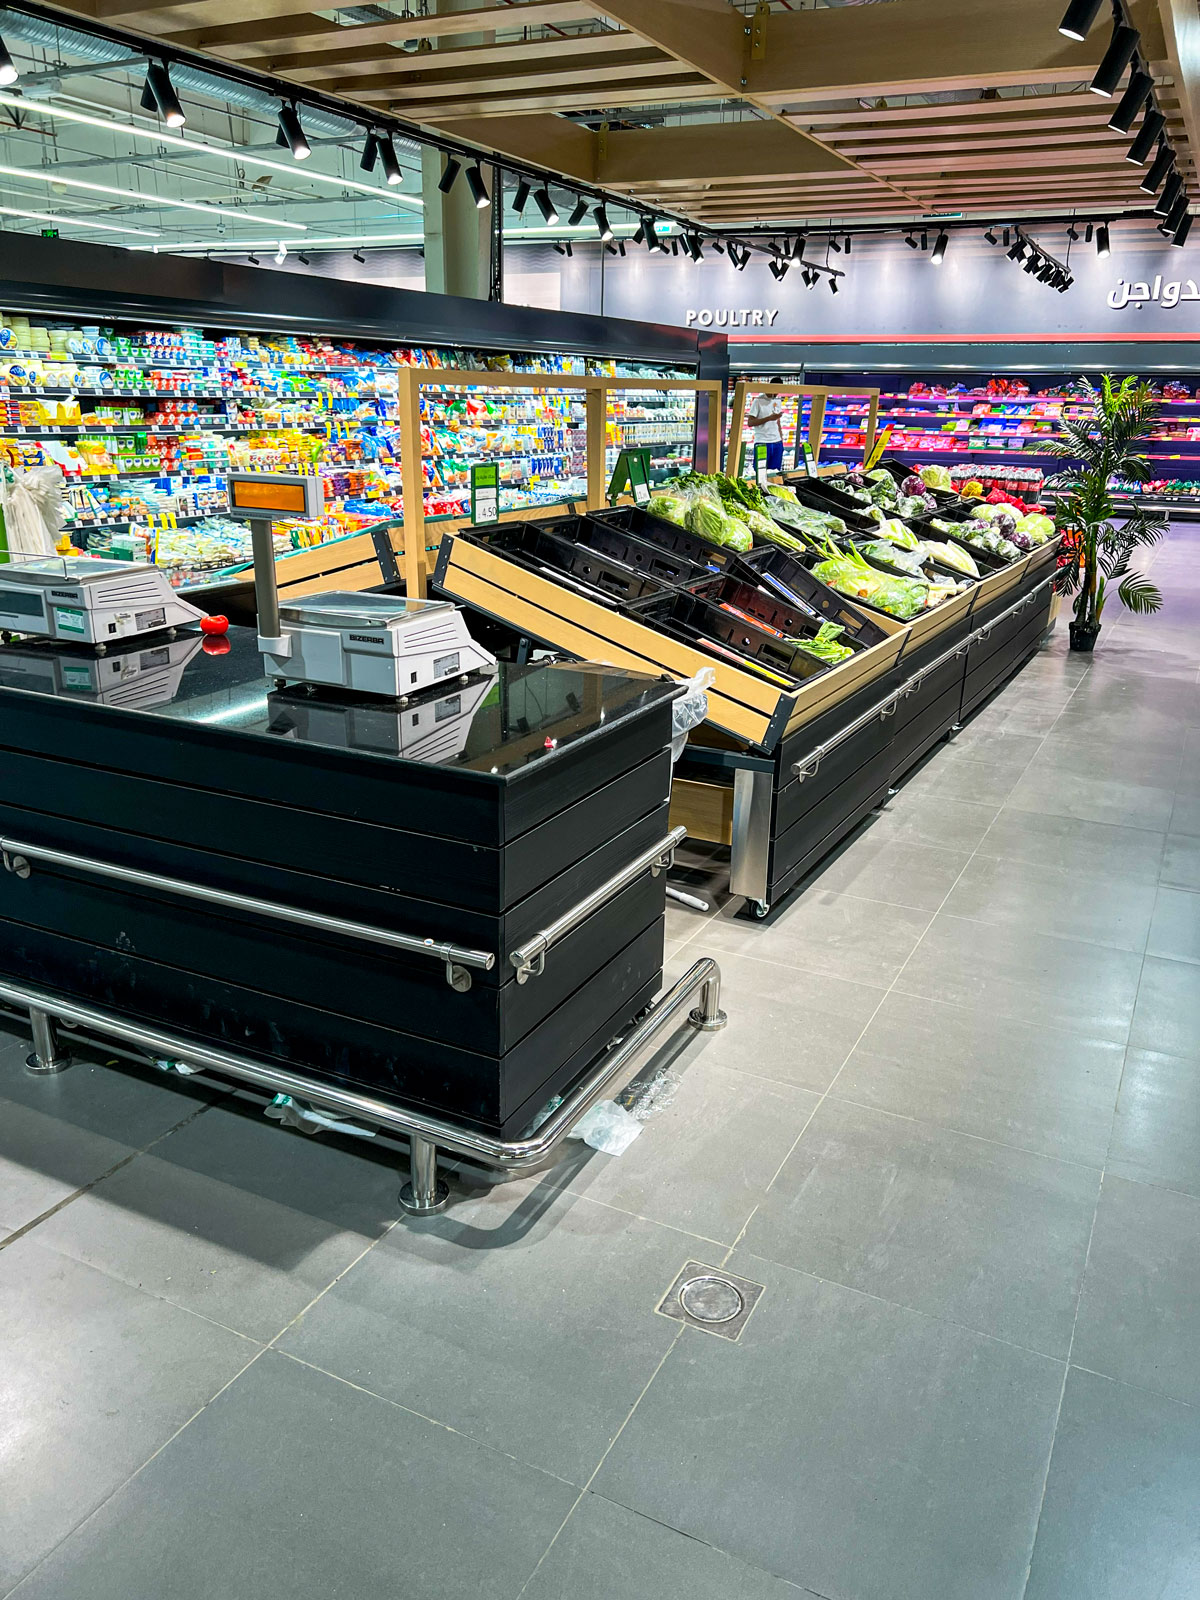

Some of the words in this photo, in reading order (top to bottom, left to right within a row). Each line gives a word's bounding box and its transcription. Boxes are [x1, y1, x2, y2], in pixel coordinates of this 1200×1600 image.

[1106, 274, 1200, 310] دواجن
[685, 308, 779, 327] POULTRY
[482, 506, 497, 518] 4.50
[349, 634, 384, 645] BIZERBA
